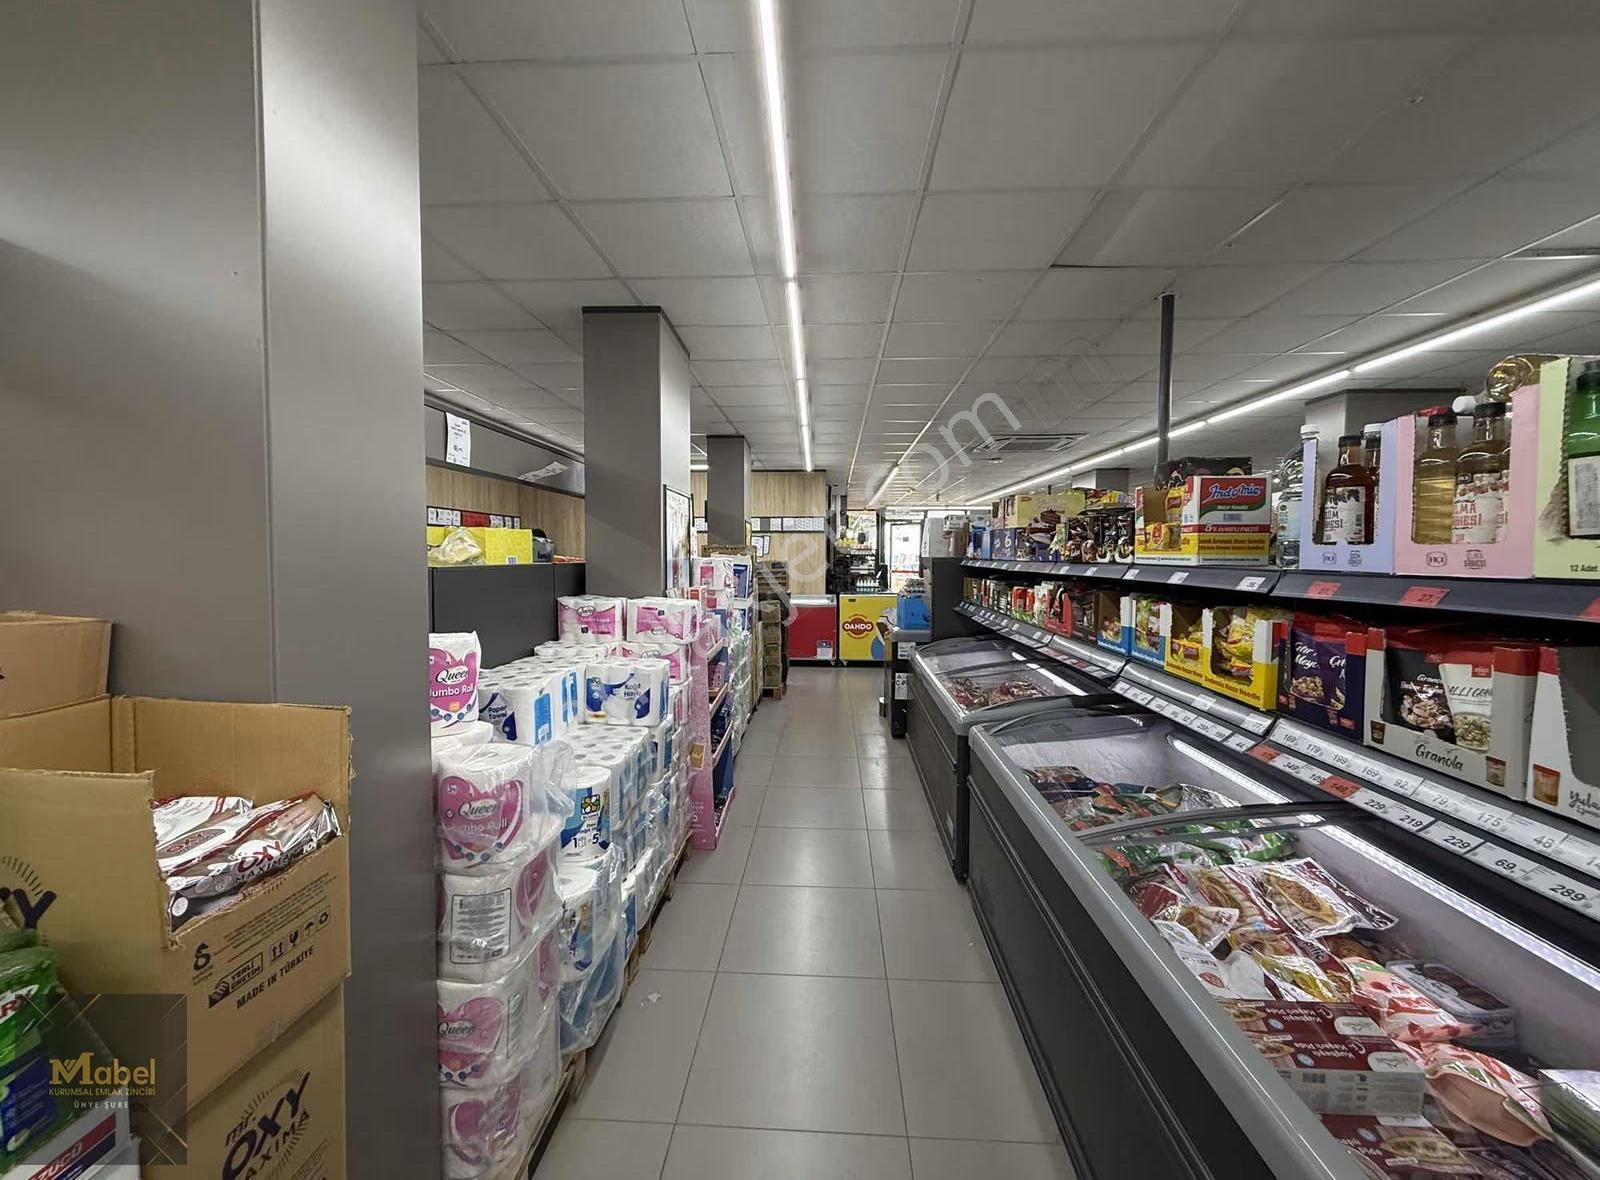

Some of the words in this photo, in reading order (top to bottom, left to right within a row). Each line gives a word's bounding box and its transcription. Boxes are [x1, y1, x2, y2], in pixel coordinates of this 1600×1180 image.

[1415, 743, 1464, 772] Granola
[1400, 814, 1423, 829] 219
[1443, 834, 1471, 850] 229
[237, 840, 285, 874] OXY
[1549, 883, 1587, 902] 289
[236, 981, 265, 1010] MADE
[267, 972, 277, 987] IN
[279, 945, 315, 976] TÜRKİYE
[437, 1020, 476, 1037] Queen
[222, 1071, 312, 1180] OXY
[244, 1107, 311, 1180] AXIMA
